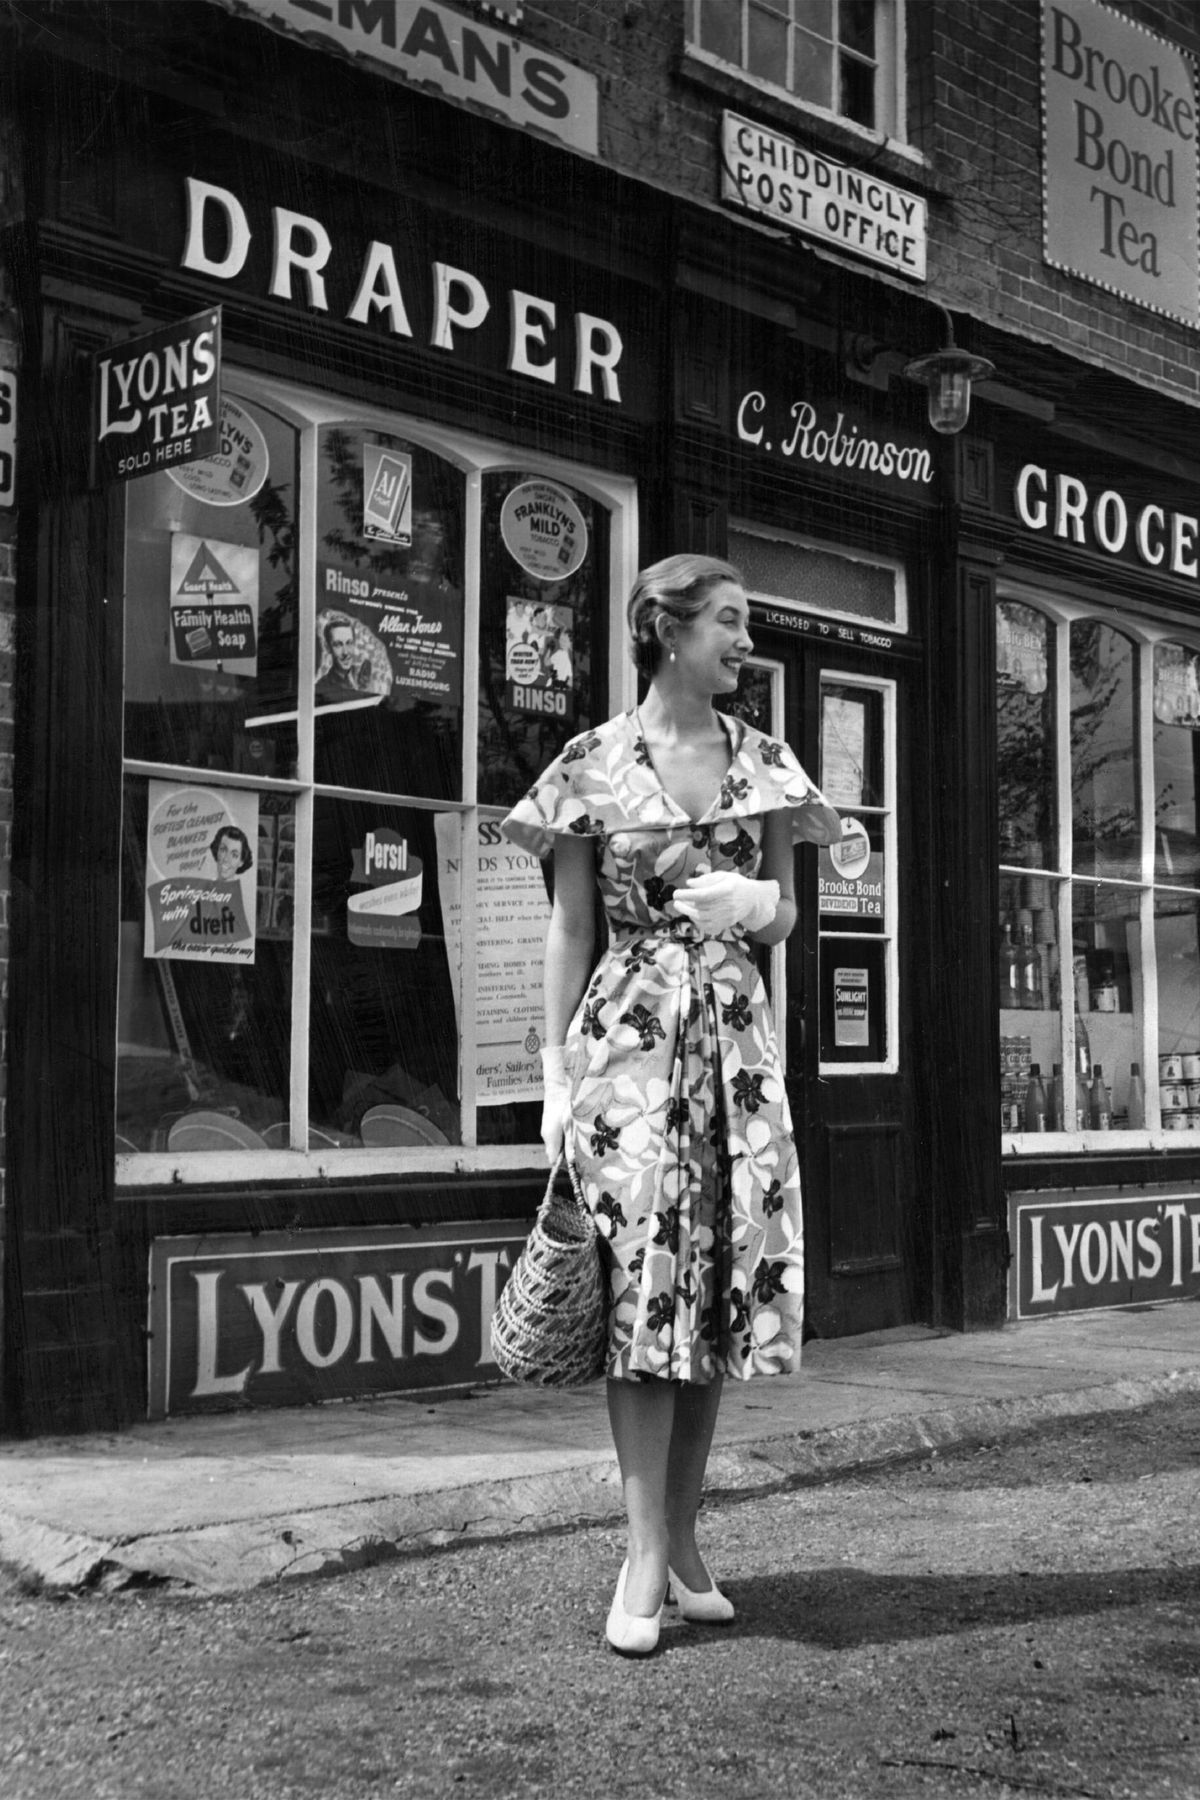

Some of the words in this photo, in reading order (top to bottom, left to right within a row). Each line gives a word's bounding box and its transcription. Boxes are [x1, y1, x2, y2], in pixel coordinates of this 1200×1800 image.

[288, 0, 570, 119] MAN'S
[1051, 6, 1194, 141] Brooke
[1074, 99, 1176, 208] Bond
[737, 127, 915, 225] CHIDDINGLY
[737, 162, 812, 220] POST
[825, 202, 916, 266] OFFICE
[1090, 185, 1161, 278] Tea
[181, 177, 622, 403] DRAPER
[148, 396, 213, 443] TEA
[737, 390, 772, 451] C.
[781, 401, 934, 483] Robinson
[118, 451, 150, 474] SOLD
[156, 438, 192, 462] HERE
[514, 502, 576, 534] FRANKLYN'S
[530, 517, 560, 536] MILD
[1014, 464, 1199, 578] GROCE
[326, 568, 369, 597] Rinso
[372, 588, 408, 601] presents
[174, 609, 212, 628] Family
[214, 609, 251, 626] Health
[379, 614, 409, 633] Allan
[411, 615, 442, 634] Jones
[766, 612, 809, 630] LICENSED
[818, 623, 829, 634] TO
[838, 628, 854, 640] SELL
[860, 632, 892, 648] TOBACCO
[217, 630, 246, 650] Soap
[396, 675, 450, 691] LUXEMBOURG
[409, 668, 436, 679] RADIO
[513, 685, 566, 716] RINSO
[166, 804, 182, 817] For
[183, 802, 198, 815] the
[365, 832, 407, 875] Persil
[819, 878, 855, 895] Brooke
[856, 880, 881, 896] Bond
[162, 904, 189, 921] with
[190, 901, 235, 935] dreft
[821, 898, 856, 910] DIVIDEND
[859, 898, 881, 914] Tea
[171, 939, 186, 952] the
[517, 936, 543, 944] GRANTS
[477, 1007, 509, 1016] NTAINING
[476, 1063, 503, 1076] diers',
[486, 1075, 522, 1088] Families
